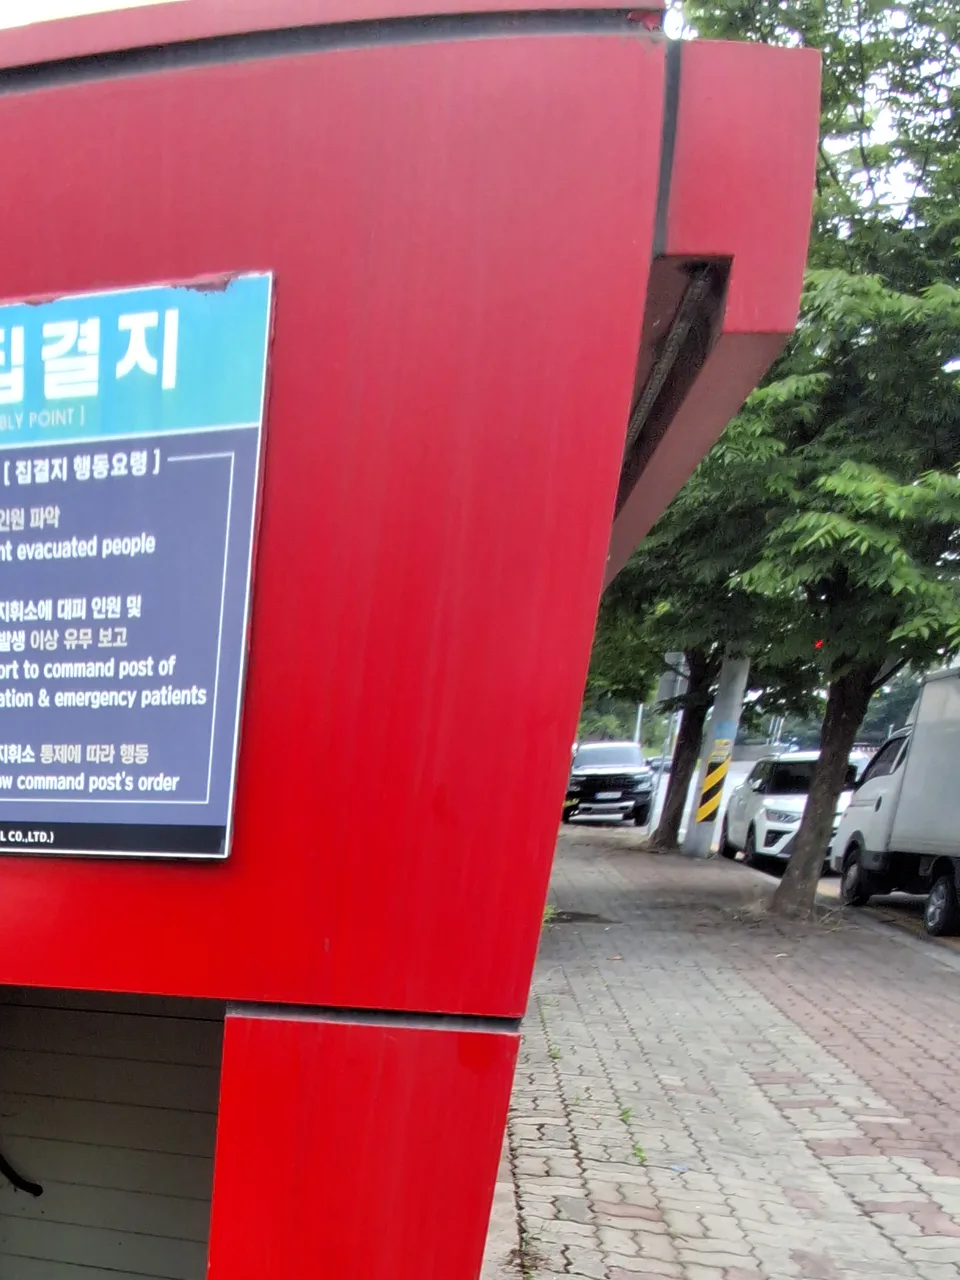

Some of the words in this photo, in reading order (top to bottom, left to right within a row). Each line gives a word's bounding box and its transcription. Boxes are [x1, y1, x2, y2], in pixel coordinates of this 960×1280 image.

[28, 408, 75, 429] POINT
[15, 456, 67, 485] 집결지
[73, 449, 148, 481] 행동요령
[30, 505, 60, 529] 파악
[17, 534, 97, 561] evacuated
[102, 531, 156, 559] people
[57, 597, 87, 621] 대피
[91, 595, 121, 619] 인원
[126, 594, 142, 618] 및
[30, 628, 59, 651] 이상
[63, 627, 92, 649] 유무
[97, 627, 128, 648] 보고
[23, 659, 39, 679] to
[43, 657, 115, 679] command
[119, 655, 153, 679] post
[158, 654, 176, 676] of
[38, 688, 50, 707] &
[54, 687, 137, 709] emergency
[141, 685, 207, 709] patients
[40, 743, 81, 764] 통제에
[86, 743, 115, 764] 따라
[120, 743, 149, 764] 행동
[17, 771, 85, 791] command
[88, 771, 134, 793] post's
[138, 773, 181, 793] order
